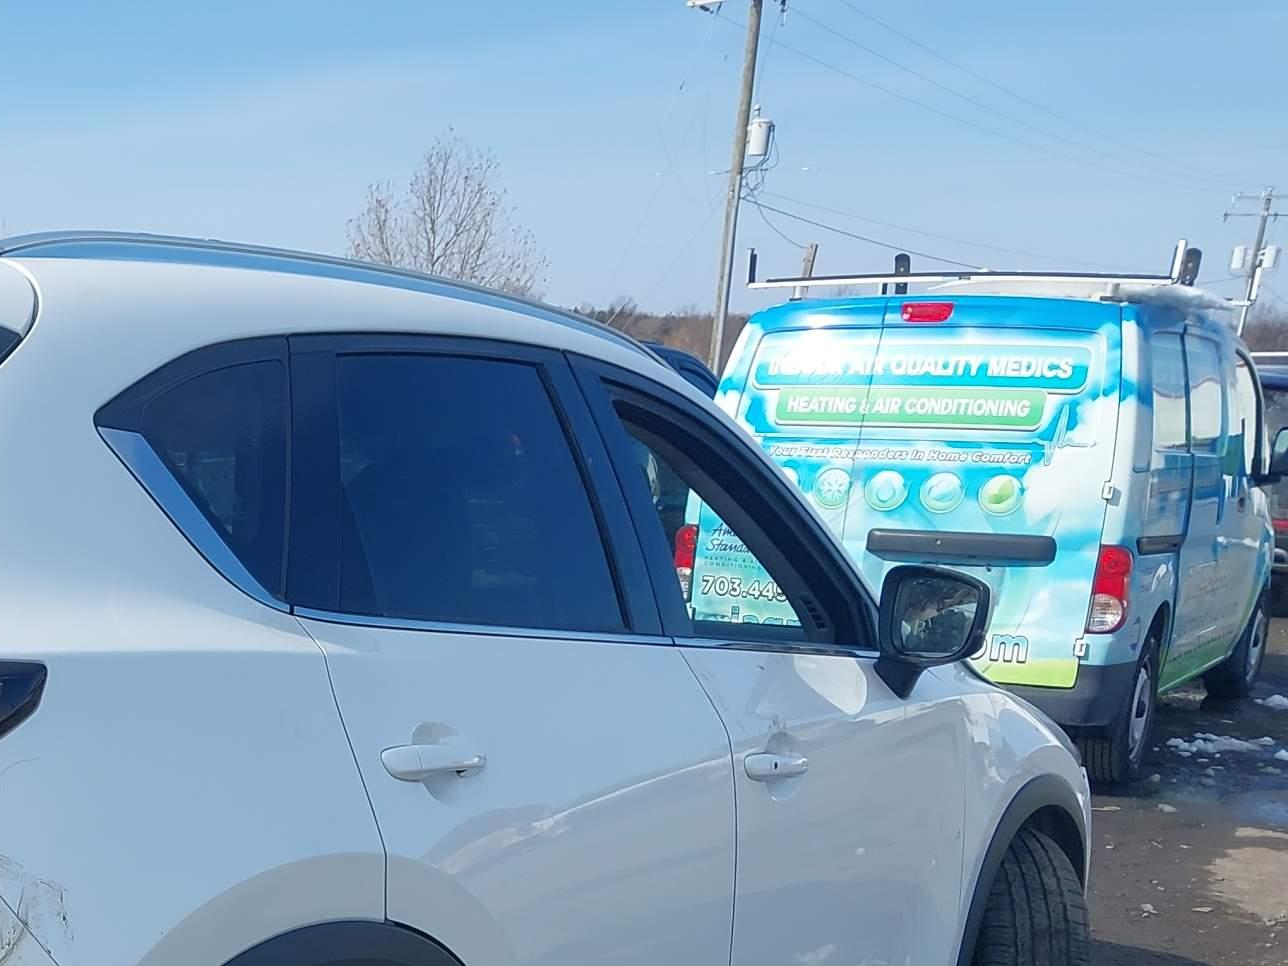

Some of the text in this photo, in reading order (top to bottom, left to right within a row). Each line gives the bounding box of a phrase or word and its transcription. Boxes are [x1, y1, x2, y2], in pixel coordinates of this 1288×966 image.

[848, 355, 884, 376] AIR
[890, 354, 984, 377] QUALITY
[987, 354, 1074, 379] MEDICS
[787, 396, 857, 414] HEATING
[872, 397, 902, 415] AIR
[904, 397, 1032, 418] CONDITIONING
[769, 444, 1032, 465] Your First Responders In Home Comfort
